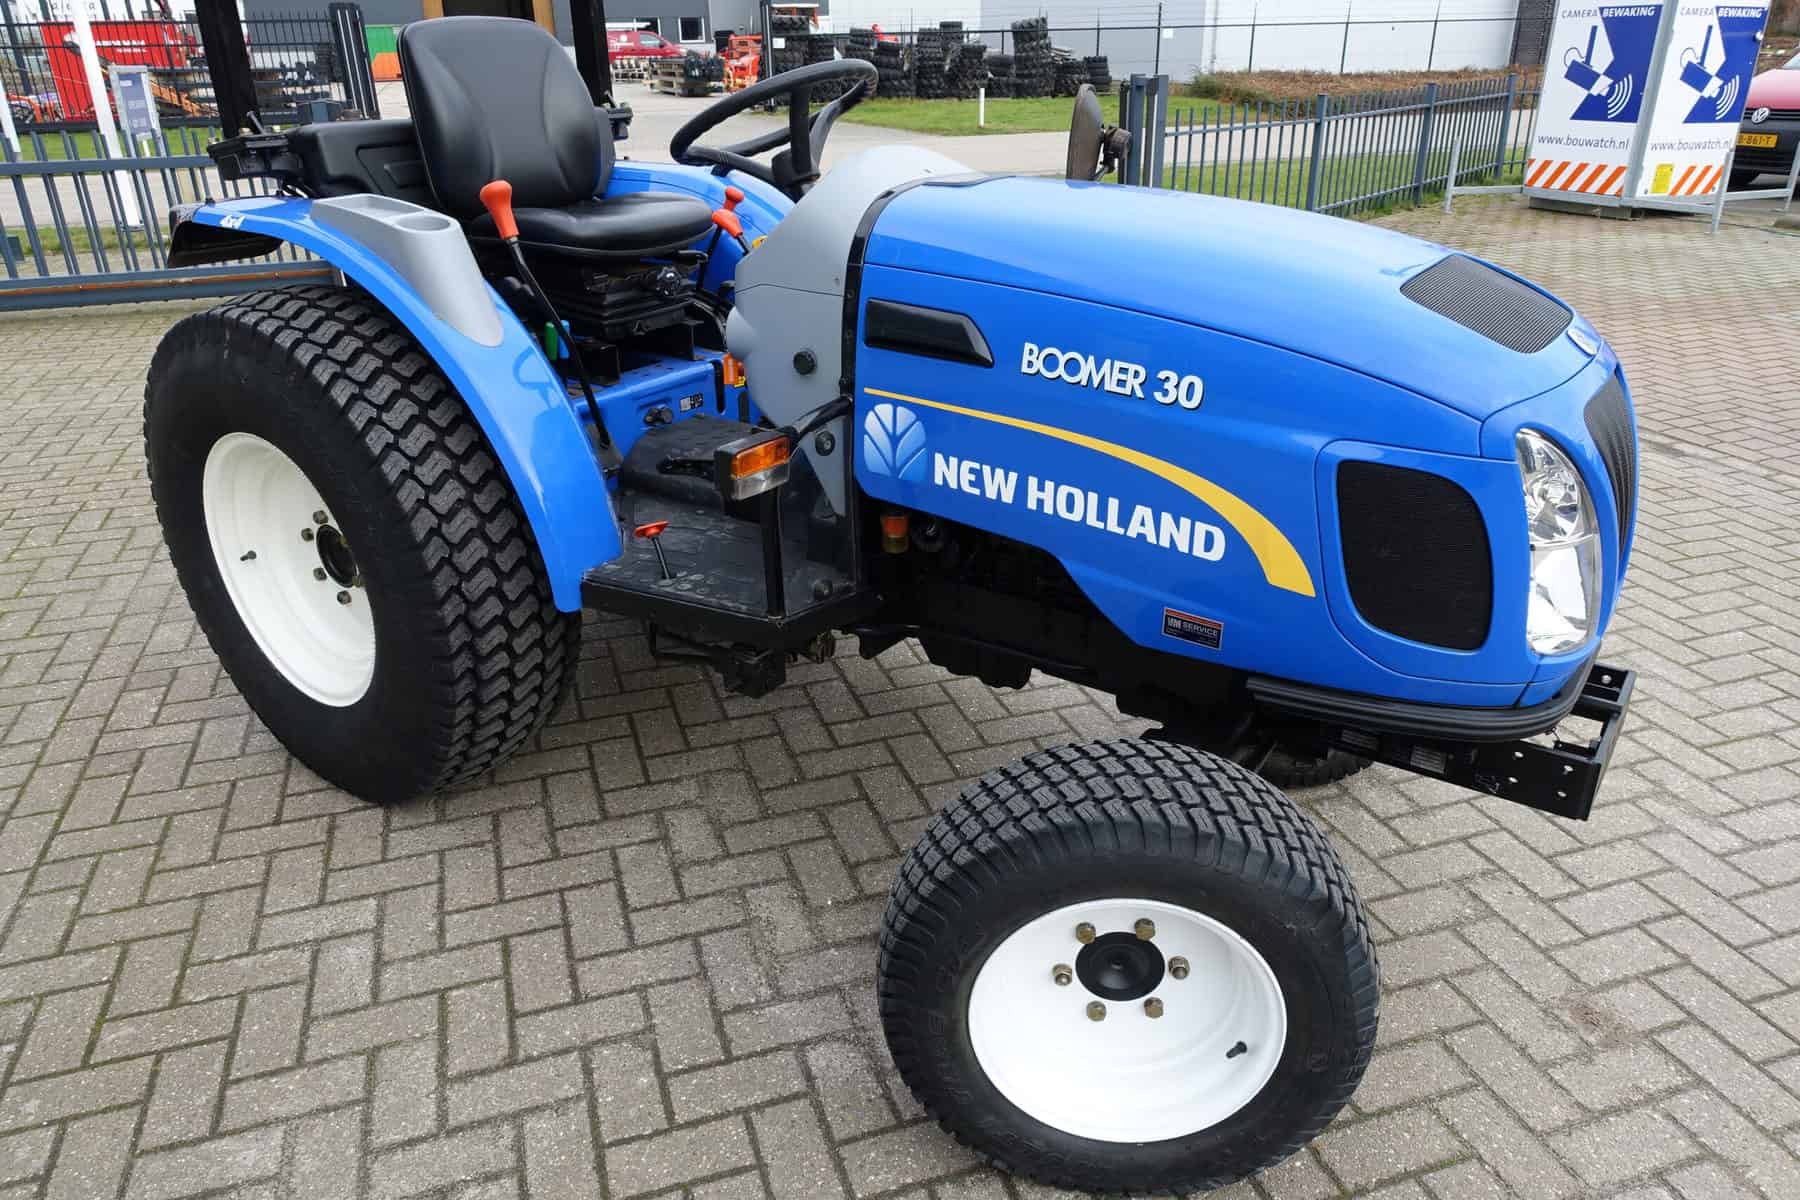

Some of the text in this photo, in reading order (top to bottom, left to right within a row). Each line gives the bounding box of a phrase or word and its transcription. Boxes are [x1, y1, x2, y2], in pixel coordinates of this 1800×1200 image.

[1562, 6, 1655, 19] CAMERA BEWAKING
[1680, 7, 1762, 18] CAMERA BEWAKING
[1538, 133, 1630, 150] www.bouwatch.nl
[1650, 138, 1732, 151] www.bouwatch.nl
[1021, 342, 1204, 409] BOOMER 30
[934, 452, 1226, 562] NEW HOLLAND
[1183, 621, 1218, 637] SERVICE
